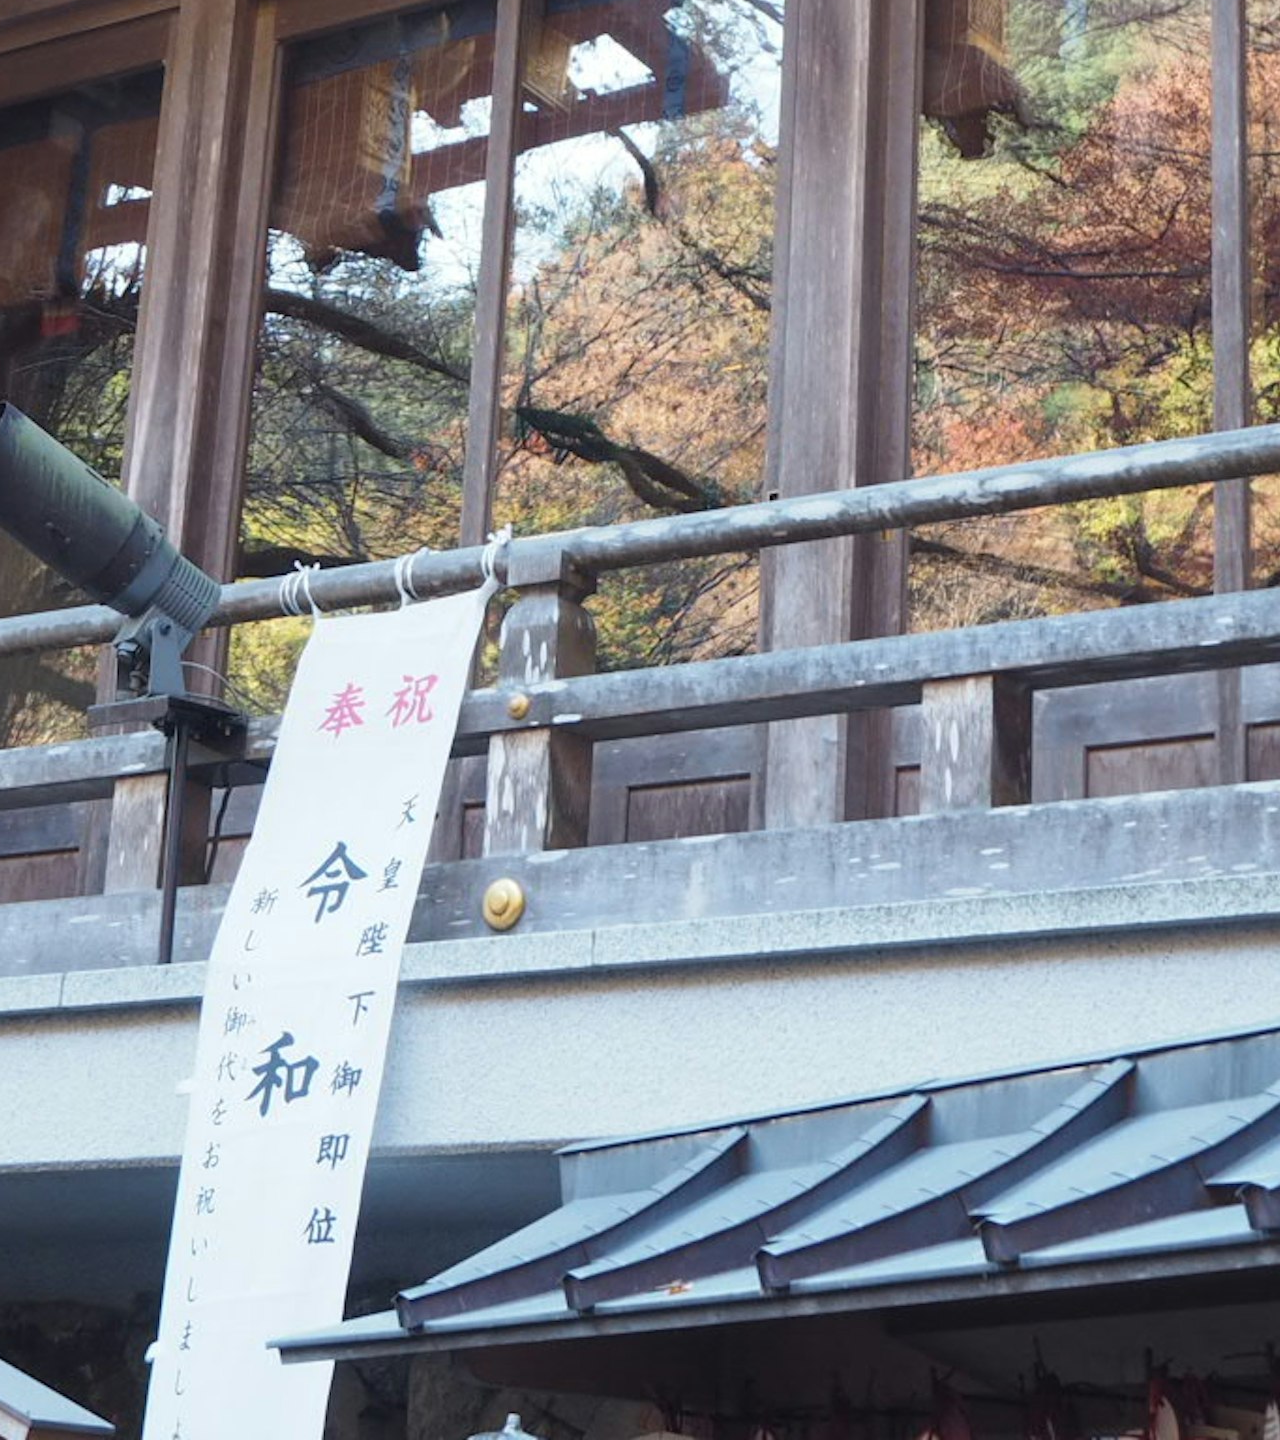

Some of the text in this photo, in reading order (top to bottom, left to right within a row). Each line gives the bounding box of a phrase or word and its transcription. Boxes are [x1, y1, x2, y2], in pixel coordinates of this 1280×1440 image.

[317, 674, 438, 739] 奉祝
[244, 841, 368, 1117] 令和
[303, 794, 419, 1244] 天皇陛下御即位
